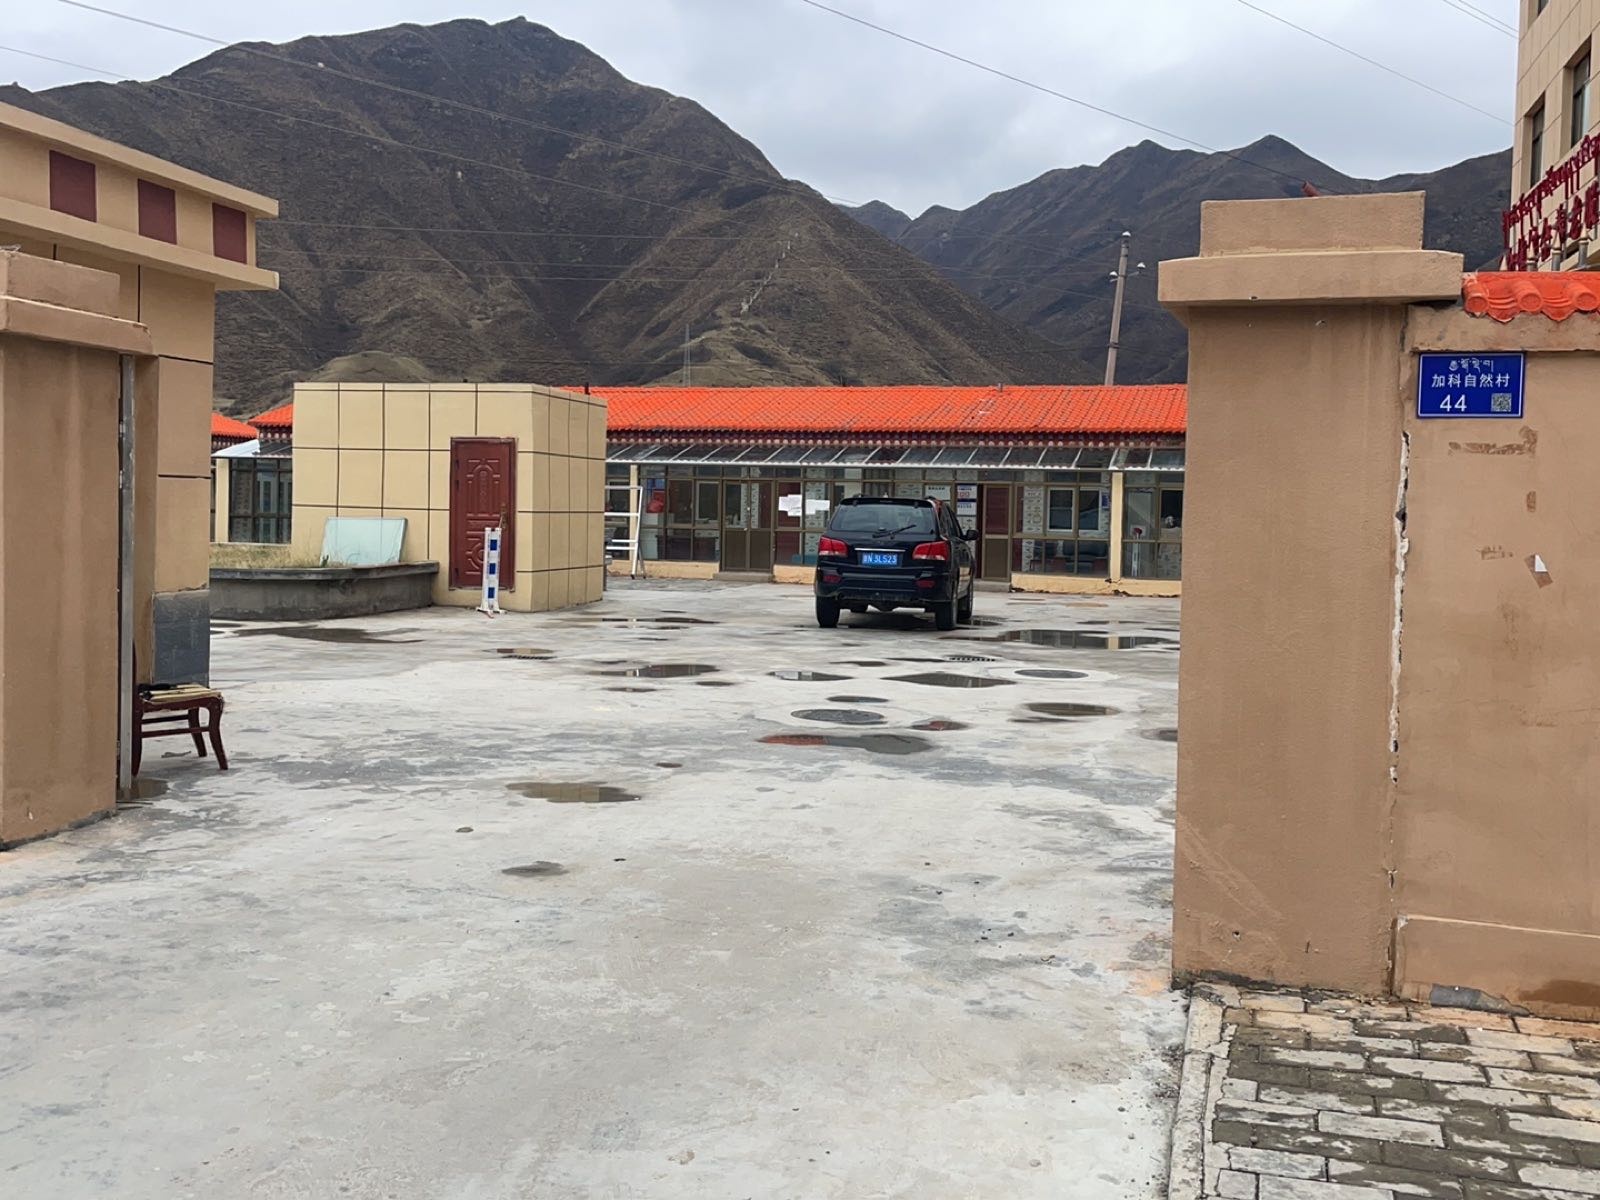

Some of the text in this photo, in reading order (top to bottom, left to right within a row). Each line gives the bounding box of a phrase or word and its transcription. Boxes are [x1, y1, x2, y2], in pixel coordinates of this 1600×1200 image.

[1431, 373, 1511, 388] 加科自然村
[1439, 394, 1467, 412] 44
